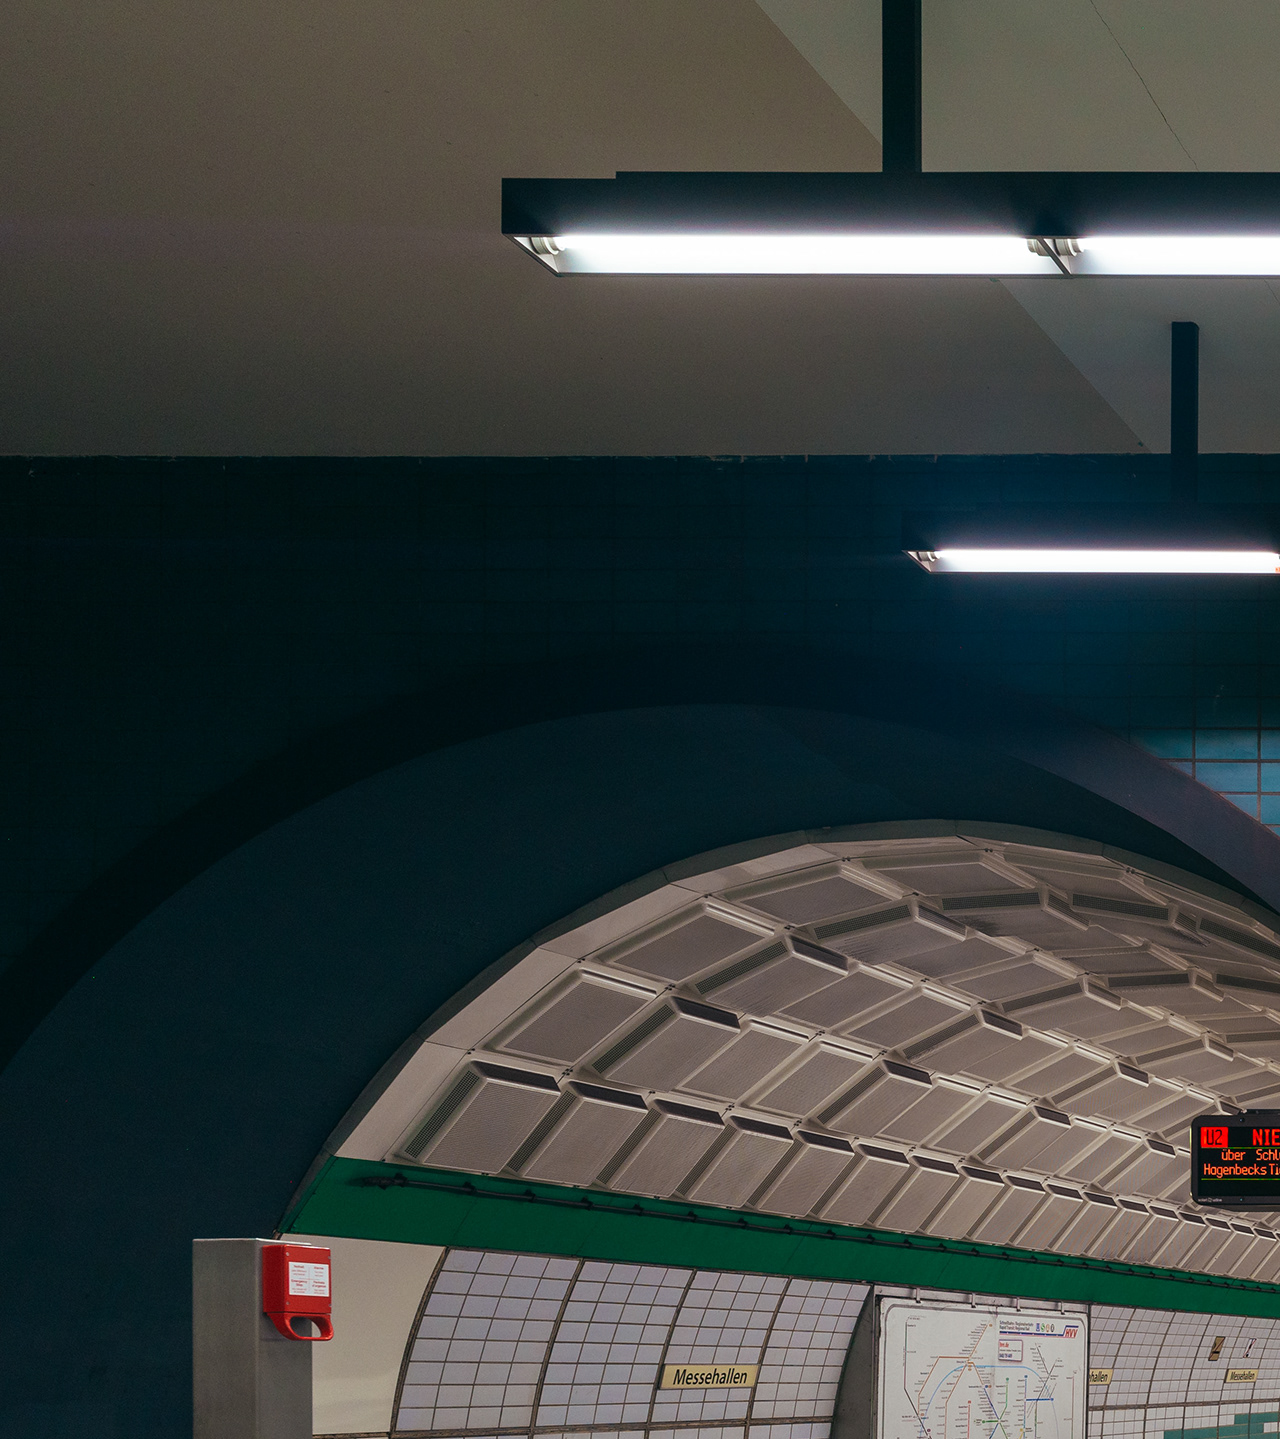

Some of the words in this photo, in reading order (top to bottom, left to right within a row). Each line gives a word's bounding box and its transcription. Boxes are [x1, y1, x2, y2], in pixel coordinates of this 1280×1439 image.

[1206, 1129, 1223, 1146] U2
[1221, 1148, 1246, 1161] über
[1203, 1163, 1267, 1179] Hagenbecks
[1065, 1328, 1078, 1338] HVV
[673, 1368, 748, 1385] Messehallen
[1089, 1372, 1108, 1383] hallen
